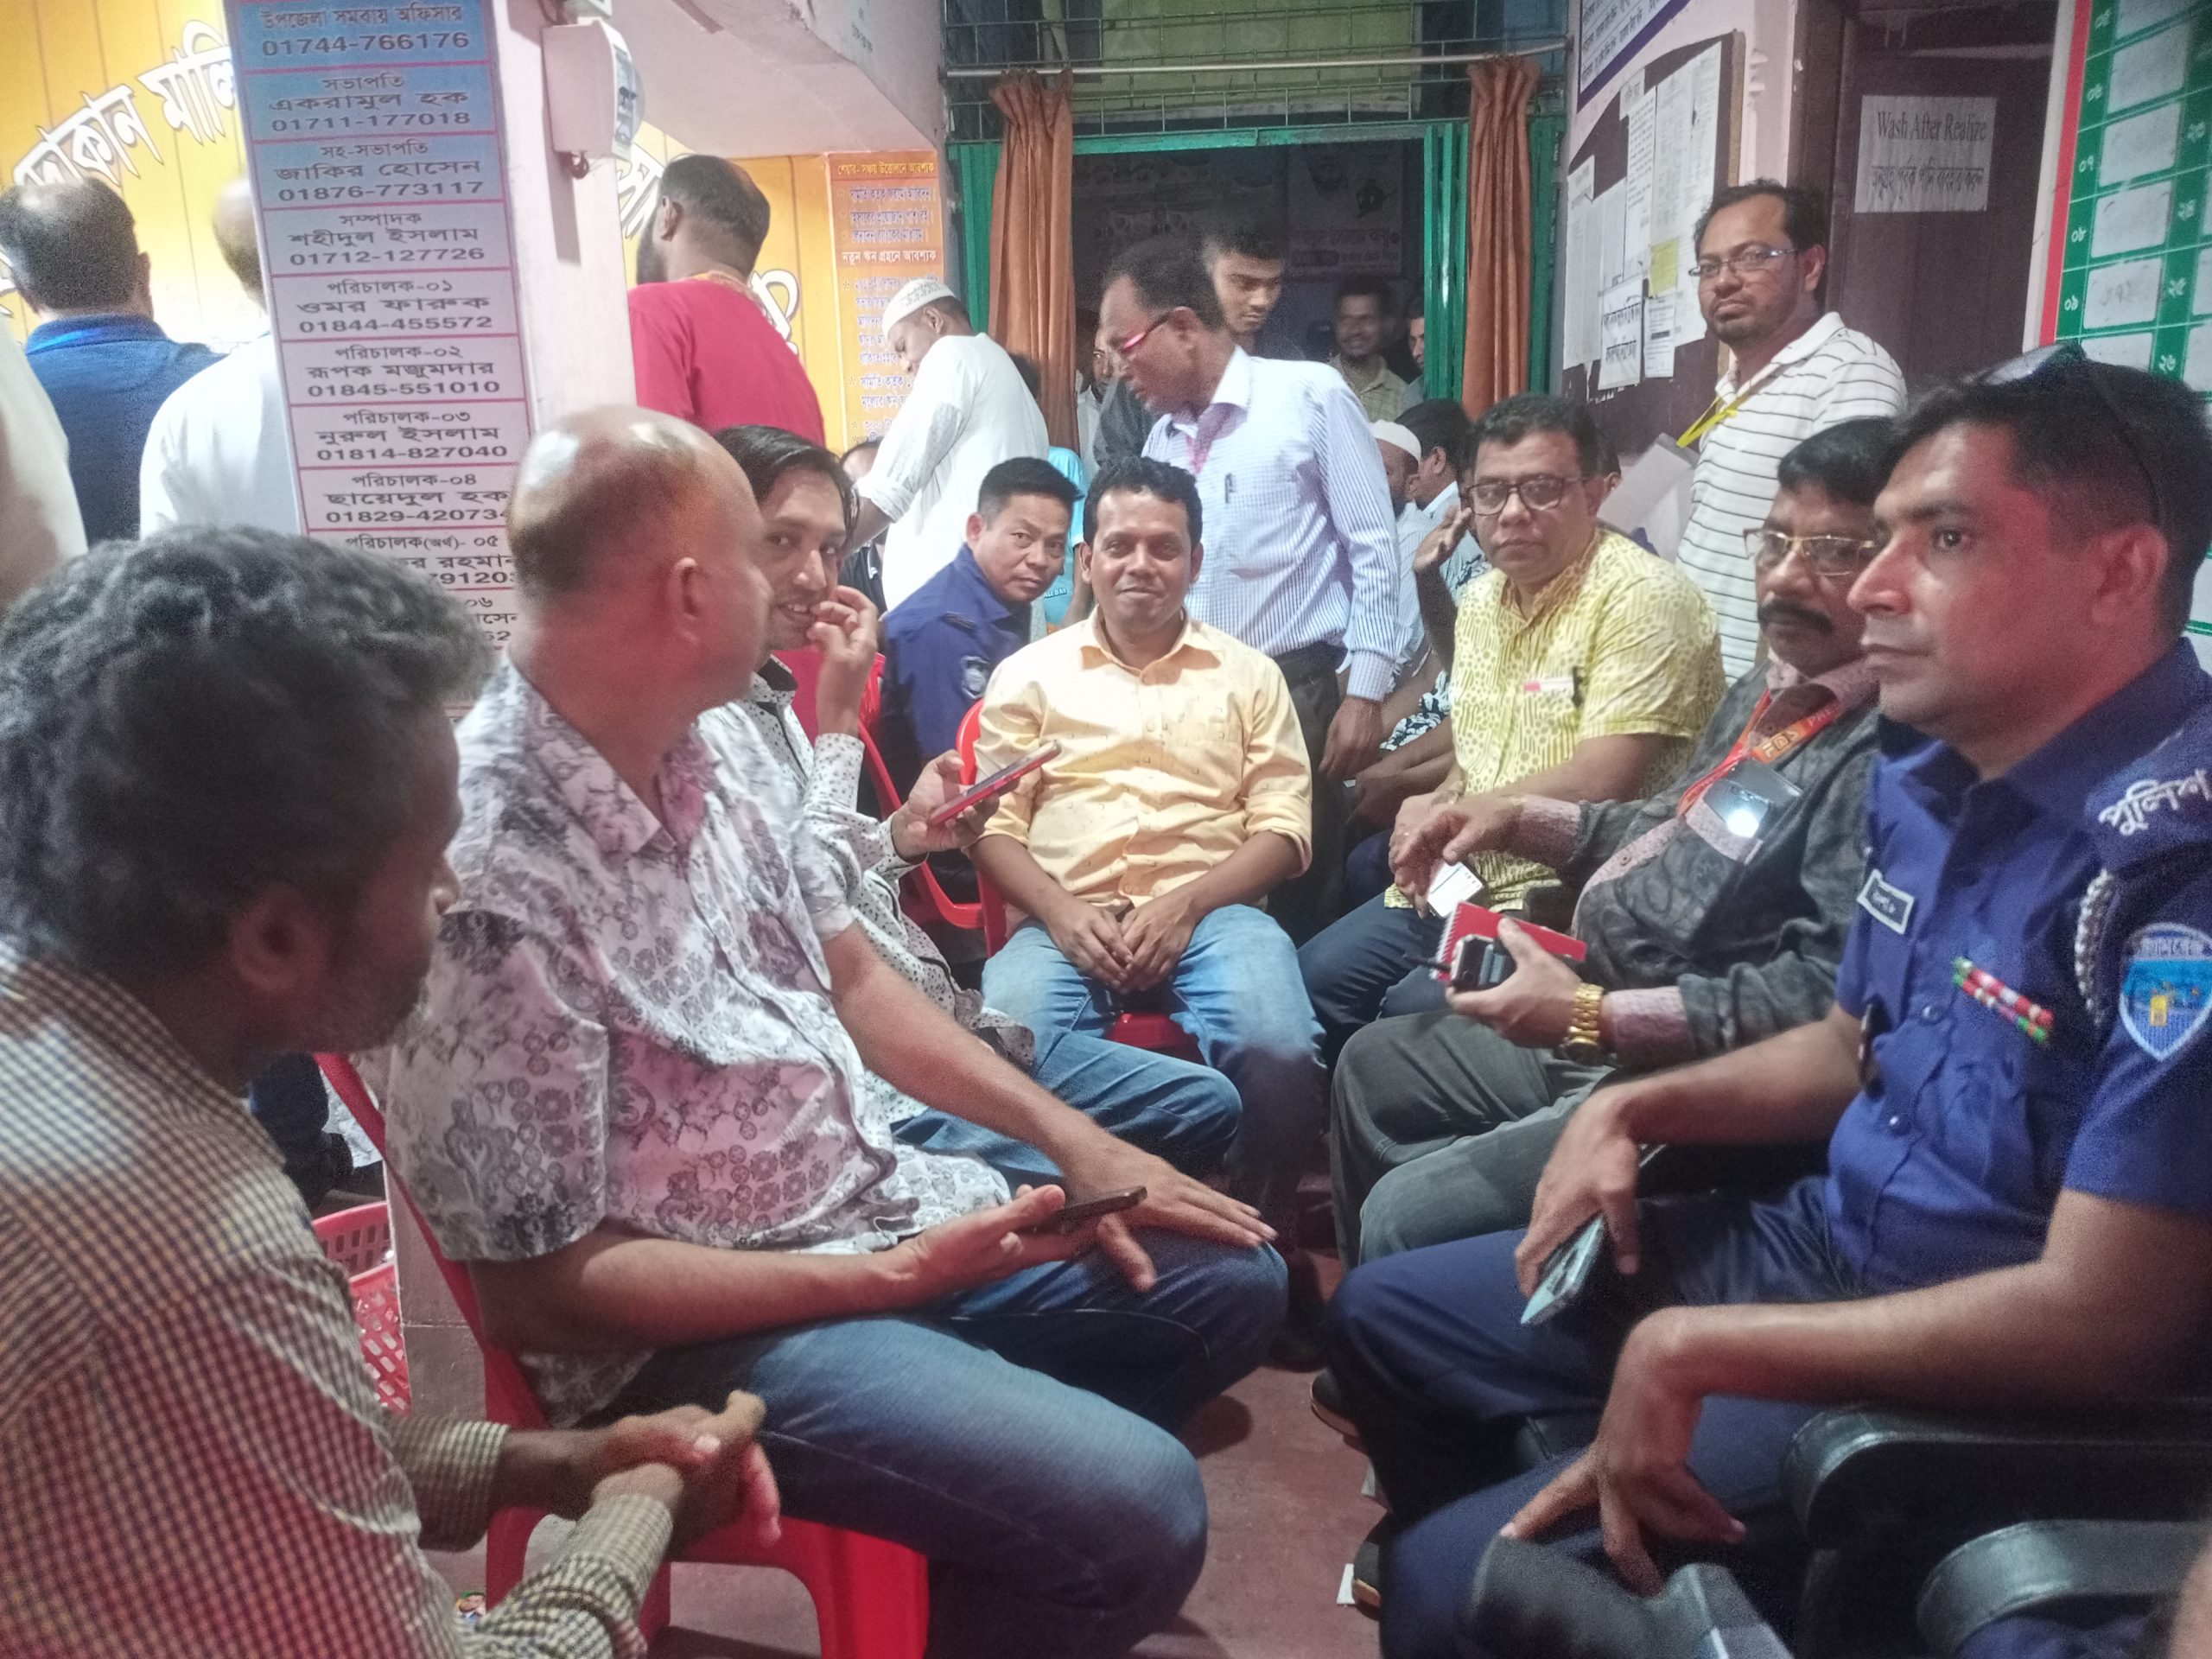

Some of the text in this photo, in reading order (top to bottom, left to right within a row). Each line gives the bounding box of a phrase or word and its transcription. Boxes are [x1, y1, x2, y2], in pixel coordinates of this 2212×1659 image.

[262, 32, 469, 56] 01744-766176
[321, 72, 404, 91] সভাপতি
[269, 92, 468, 111] একরামুল হক
[272, 112, 471, 132] 01711-177018
[1878, 111, 1907, 140] Wash
[1910, 111, 1942, 141] After
[320, 138, 429, 159] সহ-সভাপতি
[273, 160, 480, 181] জাকির হোসেন
[278, 181, 484, 201] 01876-773117
[339, 213, 422, 227] সম্পাদক
[288, 227, 479, 248] শহীদুল ইসলাম
[289, 247, 485, 266] 01712-127726
[296, 296, 490, 314] ওমর ফারুক
[299, 315, 493, 334] 01844-455572
[382, 362, 493, 379] মজুমদার
[308, 381, 500, 397] 01845-551010
[398, 427, 500, 442] ইসলাম
[317, 445, 507, 461] 01814-827040
[457, 490, 508, 503] হক
